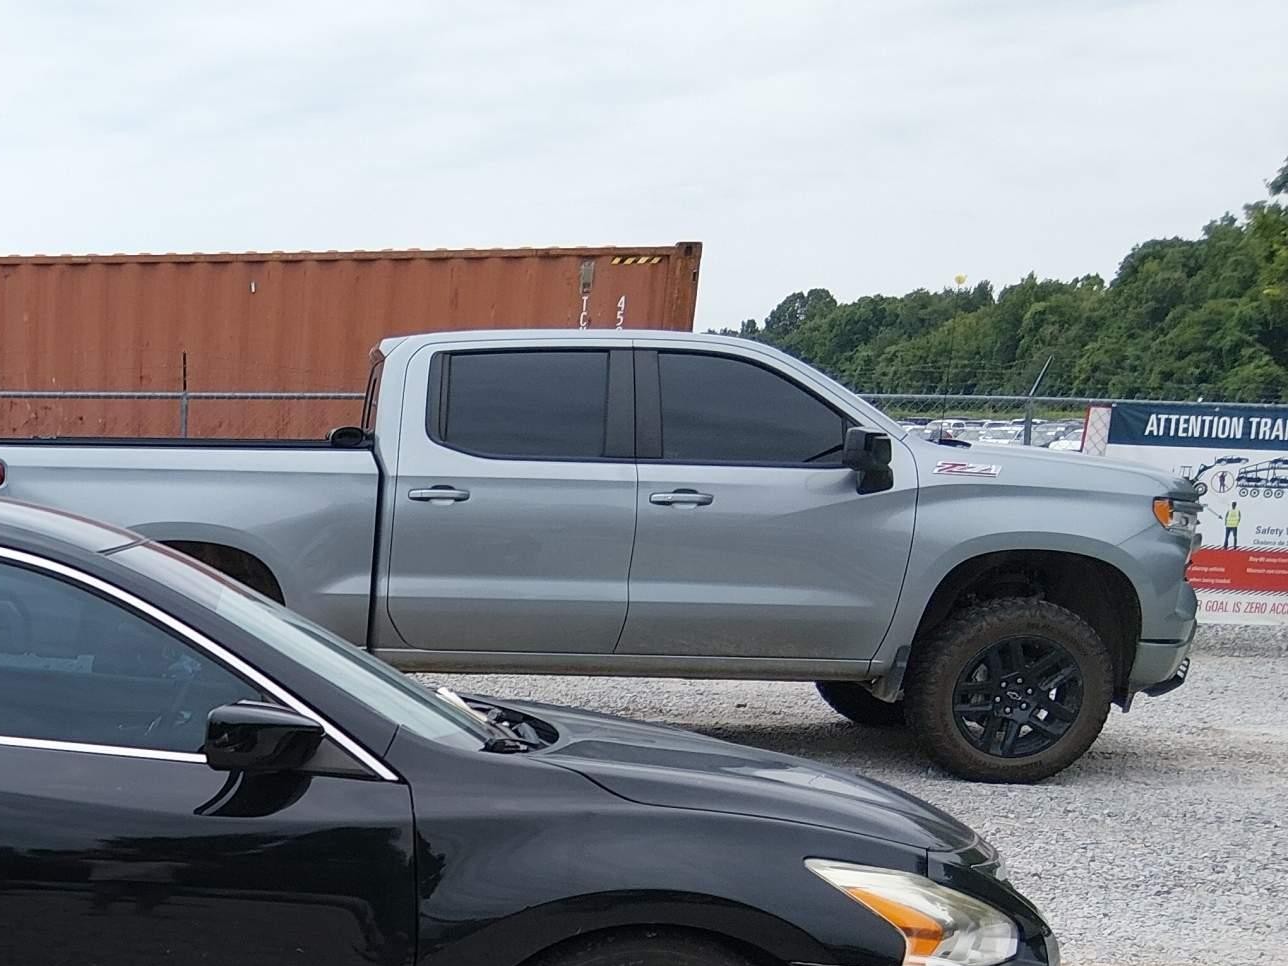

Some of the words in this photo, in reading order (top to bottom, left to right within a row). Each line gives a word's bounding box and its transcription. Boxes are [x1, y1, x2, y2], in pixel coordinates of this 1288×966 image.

[579, 296, 589, 330] TC
[616, 295, 626, 330] 45
[1144, 413, 1244, 439] ATTENTION
[1249, 417, 1288, 441] TRA
[1255, 525, 1283, 537] Safety
[1205, 600, 1230, 613] GOAL
[1232, 601, 1242, 613] IS
[1244, 602, 1267, 614] ZERO
[1269, 602, 1288, 615] ACC
